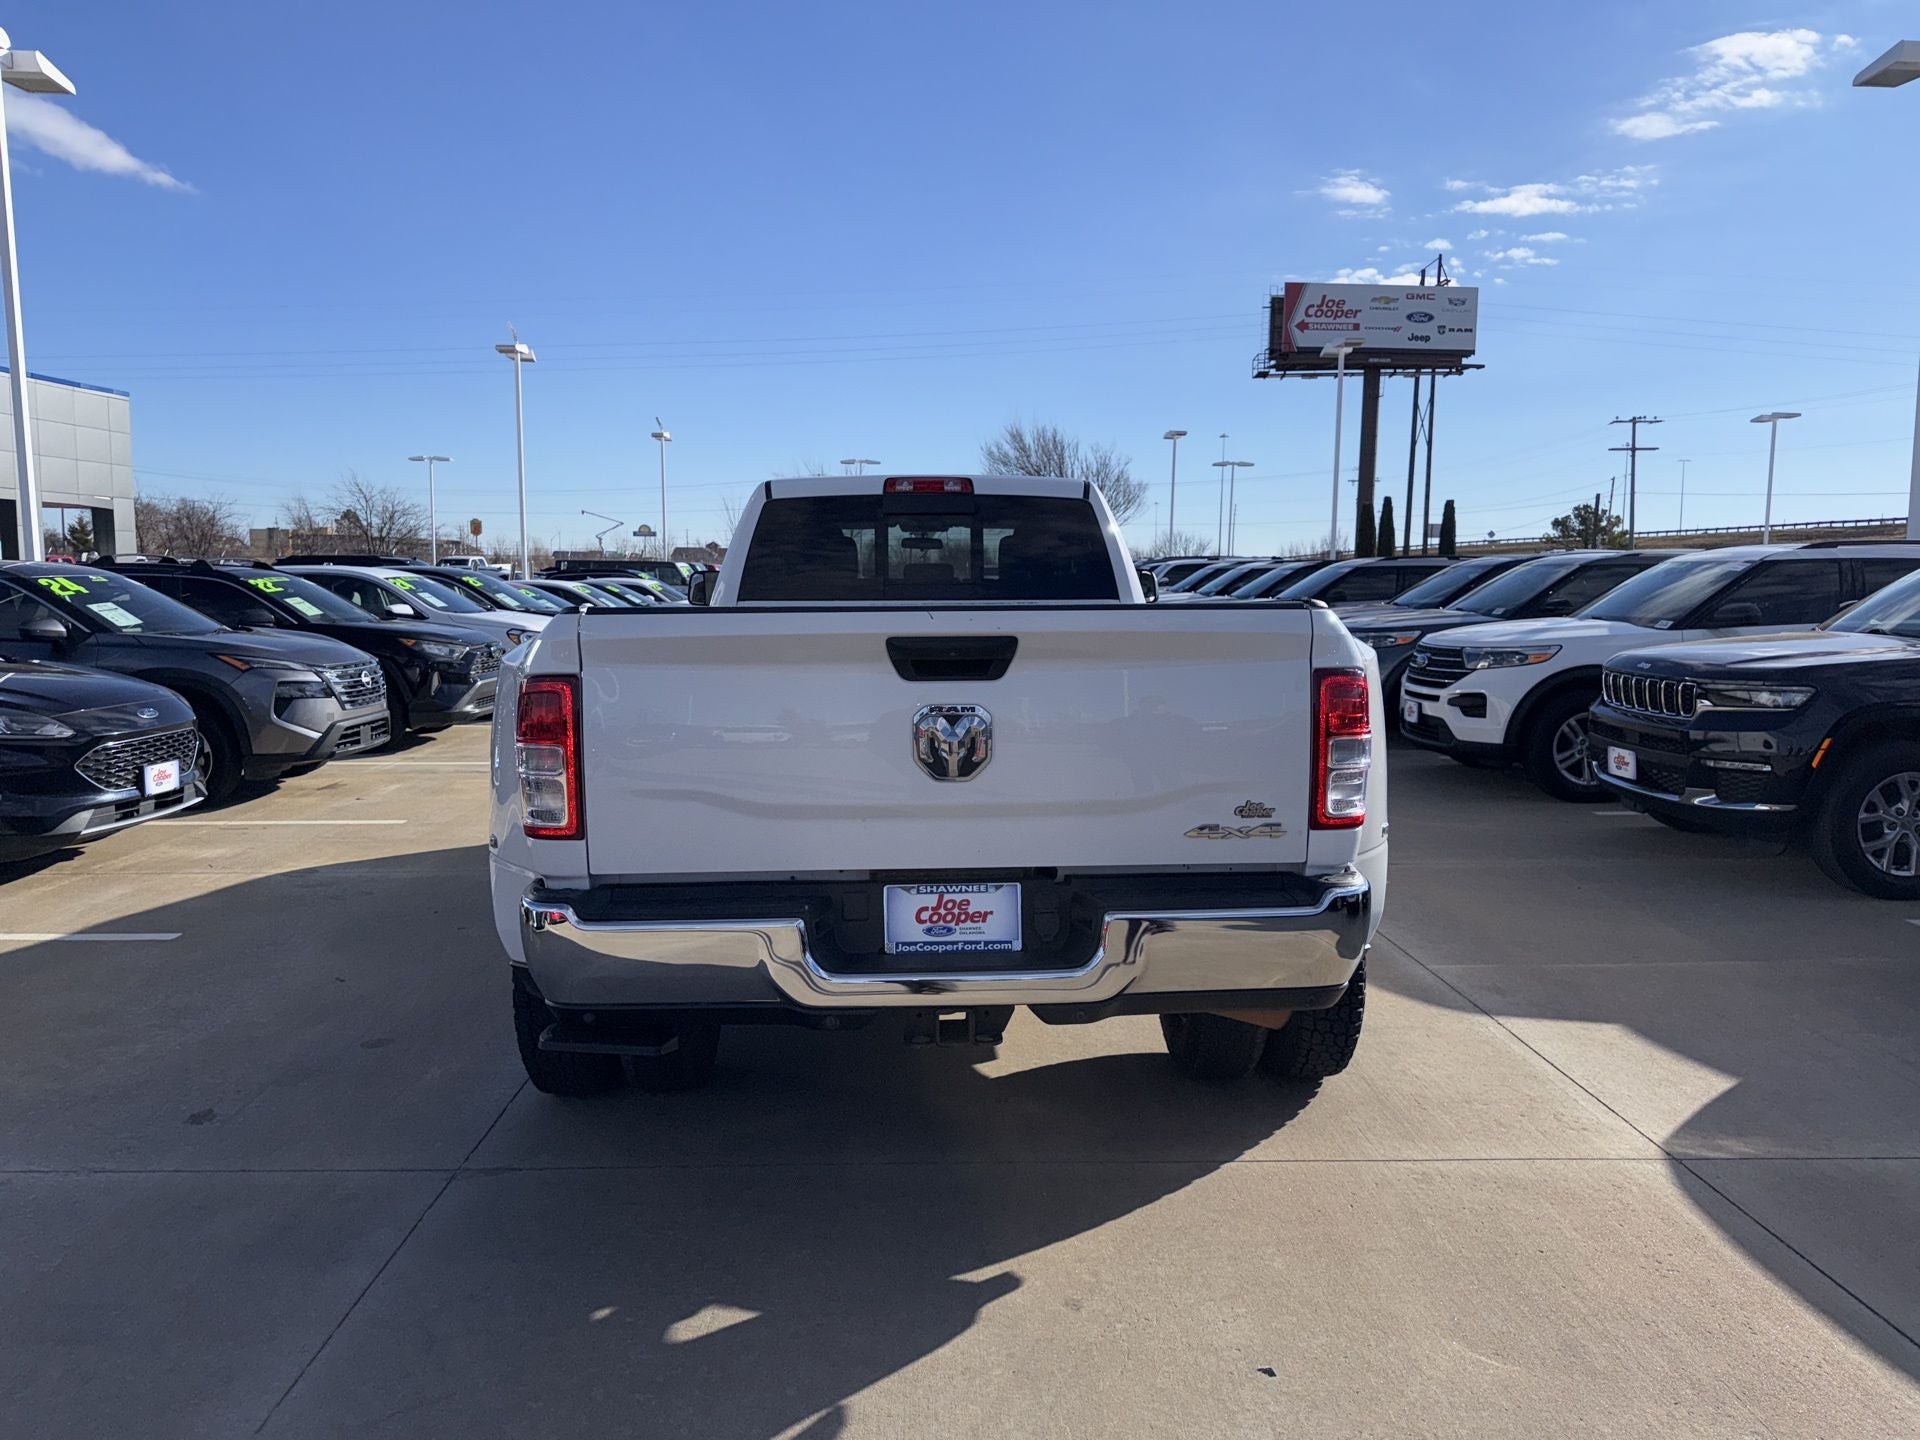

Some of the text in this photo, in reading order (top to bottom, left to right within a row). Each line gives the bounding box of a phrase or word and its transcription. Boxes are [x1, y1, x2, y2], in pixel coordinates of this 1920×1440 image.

[1316, 294, 1346, 309] Joe
[1406, 292, 1436, 300] GMC
[1304, 304, 1362, 320] Cooper
[1308, 323, 1354, 331] SHAWNEE
[1407, 332, 1431, 343] Jeep
[37, 576, 91, 597] 24
[1245, 800, 1265, 810] Joe
[1234, 806, 1276, 818] Cooper
[918, 885, 987, 893] SHAWNEE
[930, 893, 971, 912] Joe
[915, 906, 994, 926] Cooper
[896, 942, 1012, 953] JoeCooperFord.com
